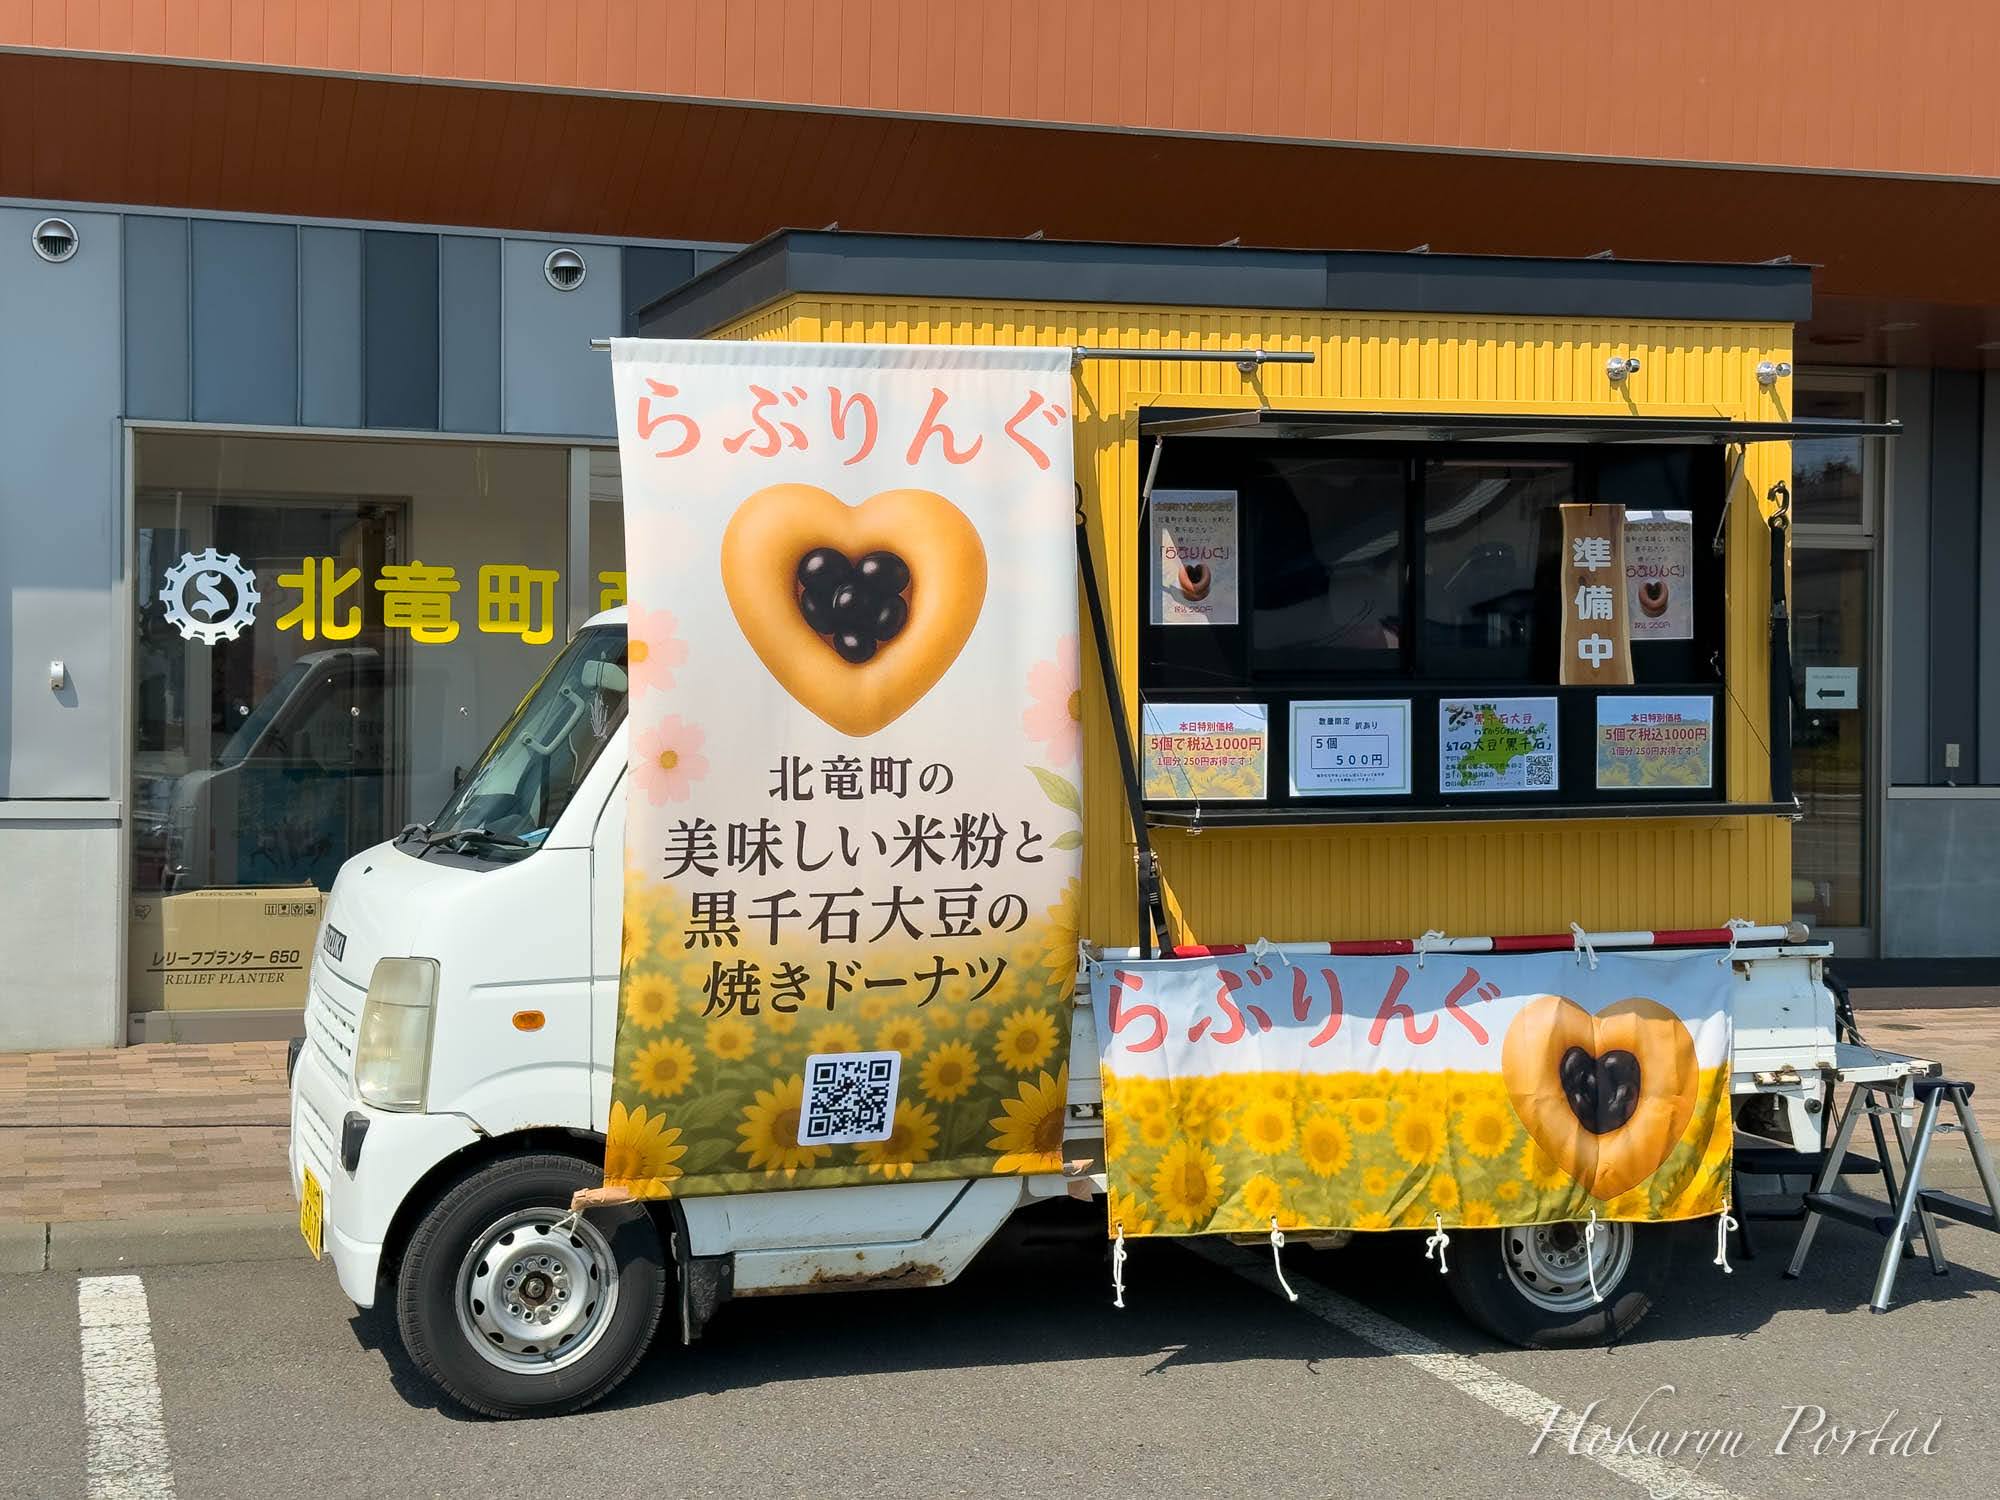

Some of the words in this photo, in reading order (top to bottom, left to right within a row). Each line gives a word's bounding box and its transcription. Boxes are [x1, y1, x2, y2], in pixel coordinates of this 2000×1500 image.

[637, 378, 1067, 470] らぶりんぐ
[276, 556, 627, 645] 北竜町
[1572, 537, 1613, 668] 準備中
[1179, 722, 1235, 732] 本日特別価格
[1474, 713, 1532, 725] 黒千石大豆
[1631, 713, 1682, 723] 本日特別価格
[1151, 736, 1262, 751] 5個で税込1000円
[1446, 737, 1552, 752] 幻の大豆「黒千石」
[1605, 727, 1707, 741] 5個で税込1000円
[768, 755, 955, 802] 北竜町の
[662, 811, 1045, 880] 美味しい米粉と
[683, 882, 1029, 950] 黒千石大豆の
[152, 950, 265, 966] レリーフプランター
[269, 950, 300, 964] 650
[165, 973, 216, 985] RELIEF
[219, 972, 285, 984] PLANTER
[701, 955, 1008, 1018] 焼きドーナツ
[1109, 964, 1502, 1053] らぶりんぐ
